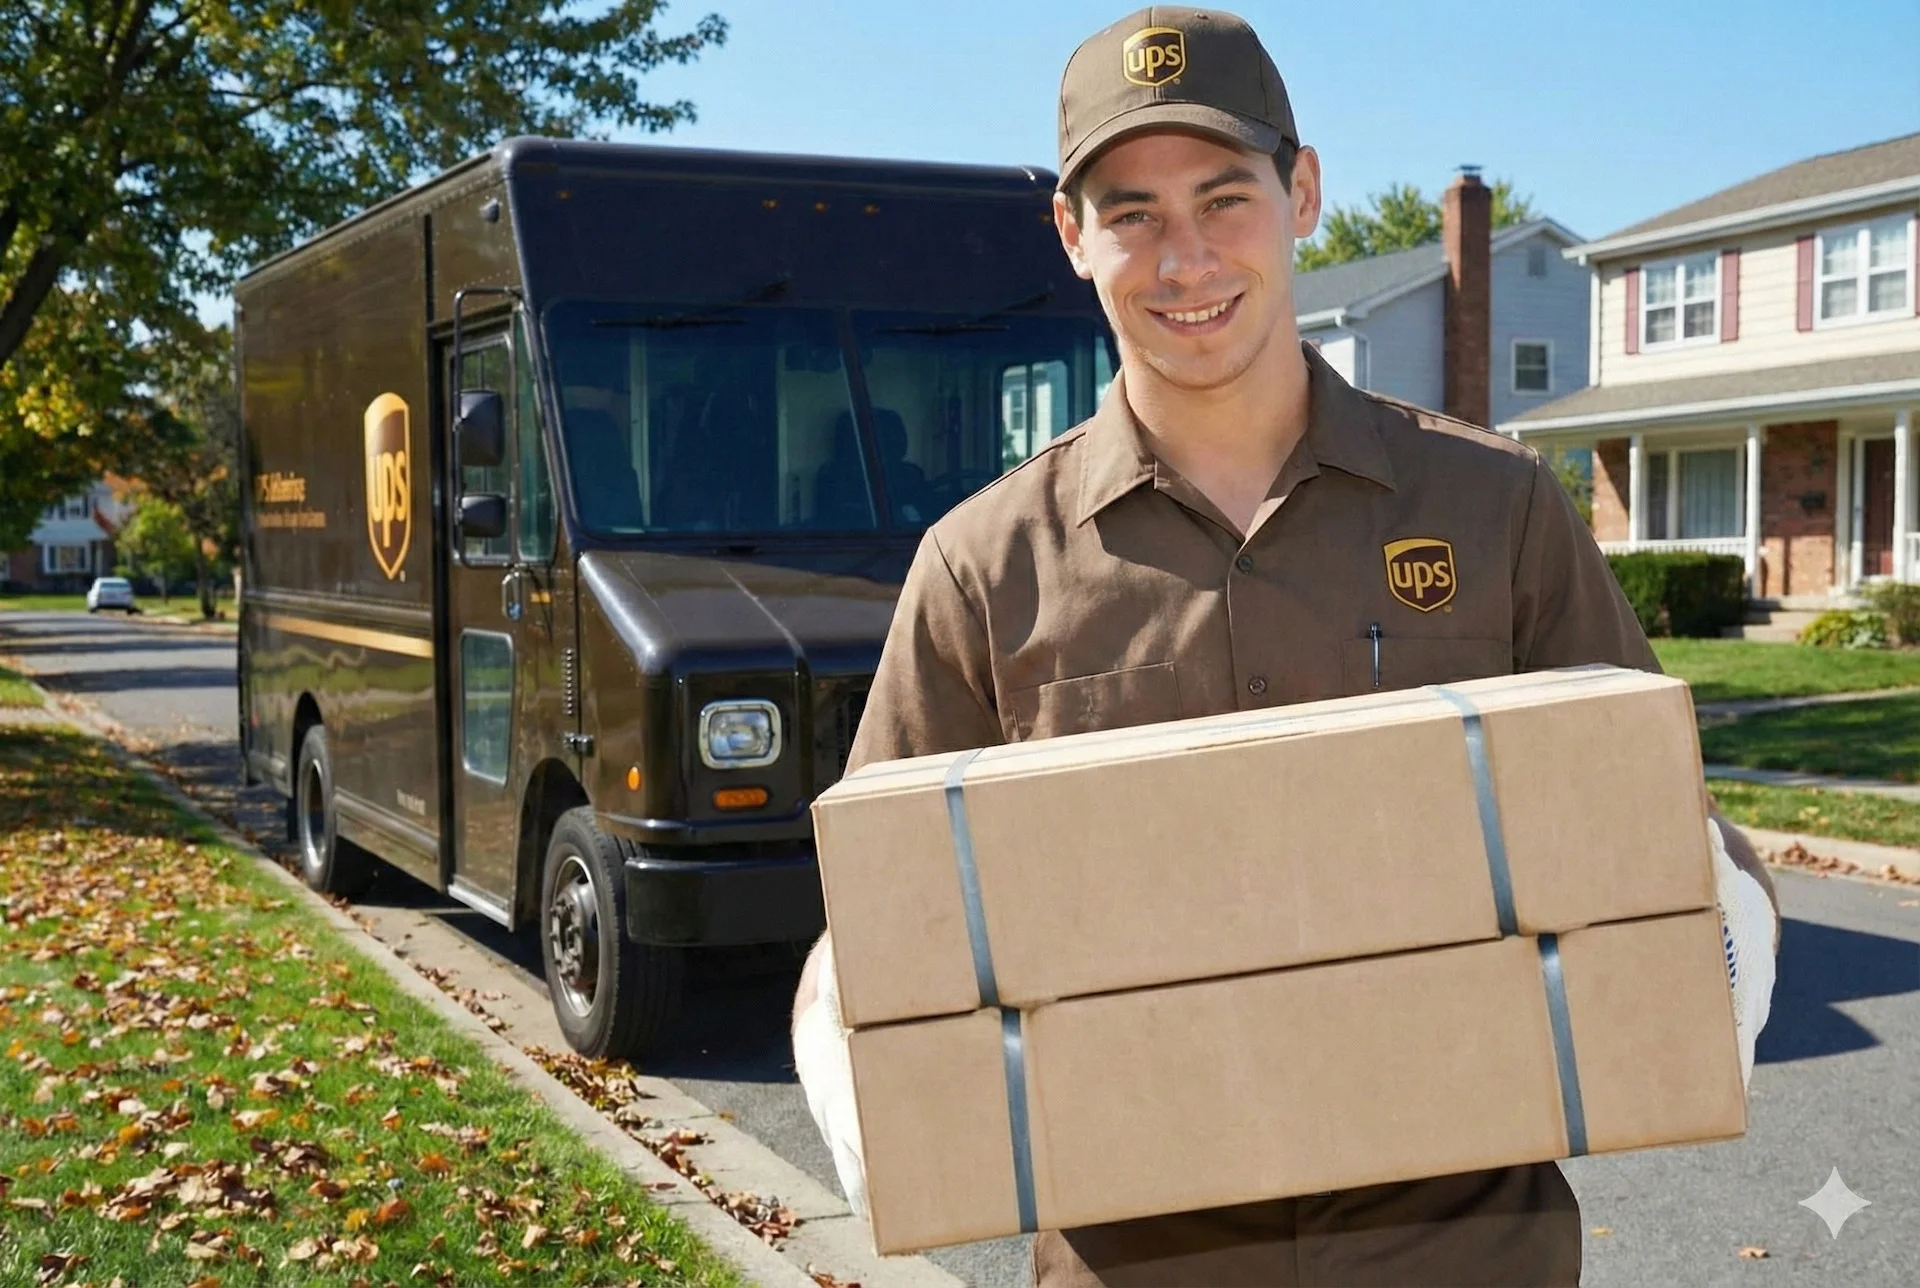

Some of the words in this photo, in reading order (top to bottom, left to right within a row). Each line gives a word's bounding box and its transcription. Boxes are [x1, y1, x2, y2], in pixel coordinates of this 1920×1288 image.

[1128, 44, 1181, 77] ups
[369, 450, 408, 548] ups
[1392, 561, 1451, 599] ups
